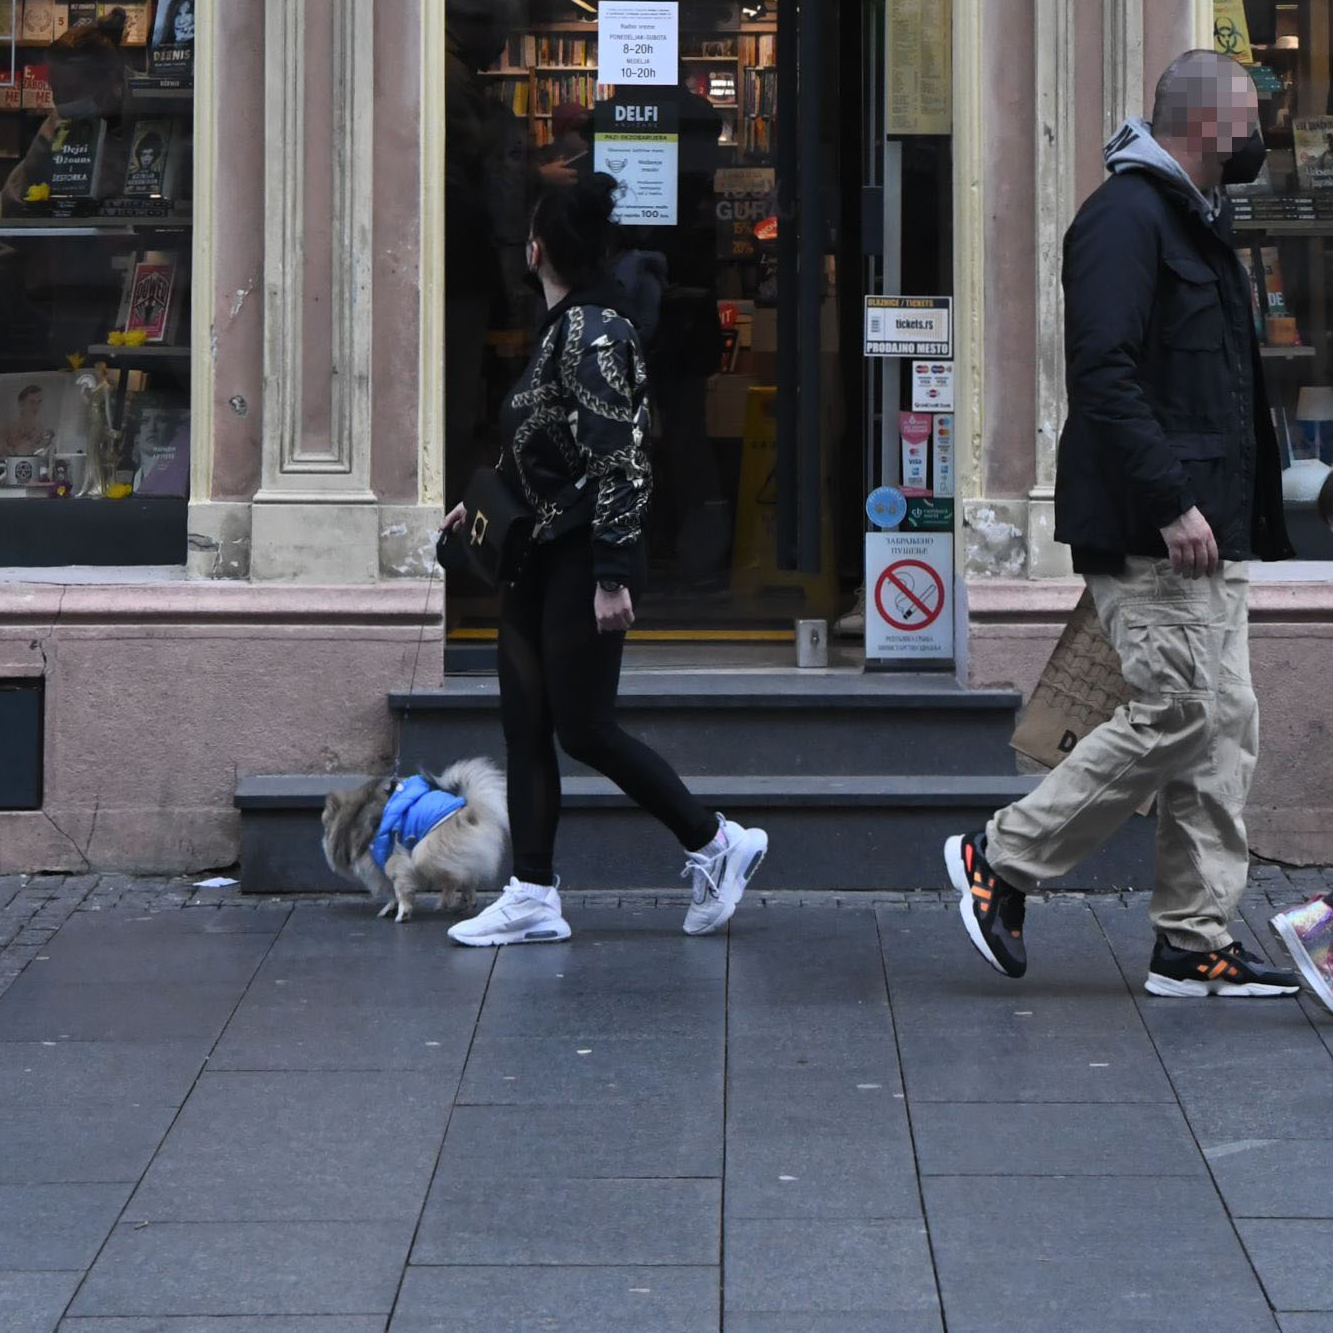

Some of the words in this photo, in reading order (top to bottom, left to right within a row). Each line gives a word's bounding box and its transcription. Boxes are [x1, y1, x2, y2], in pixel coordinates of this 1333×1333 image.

[623, 43, 654, 54] 8-20h
[621, 67, 657, 78] 10-20h
[615, 105, 659, 122] DELFI
[61, 143, 89, 155] Dejzi
[52, 155, 92, 165] Džouns
[51, 173, 89, 182] ŠESTORKA
[641, 209, 659, 218] 100
[896, 319, 934, 330] tickets.rs
[867, 342, 915, 353] PRODAJNO
[916, 343, 949, 354] MESTO
[885, 537, 934, 545] ЗАБРАЊЕНО
[891, 547, 927, 555] ПУШЕЊЕ
